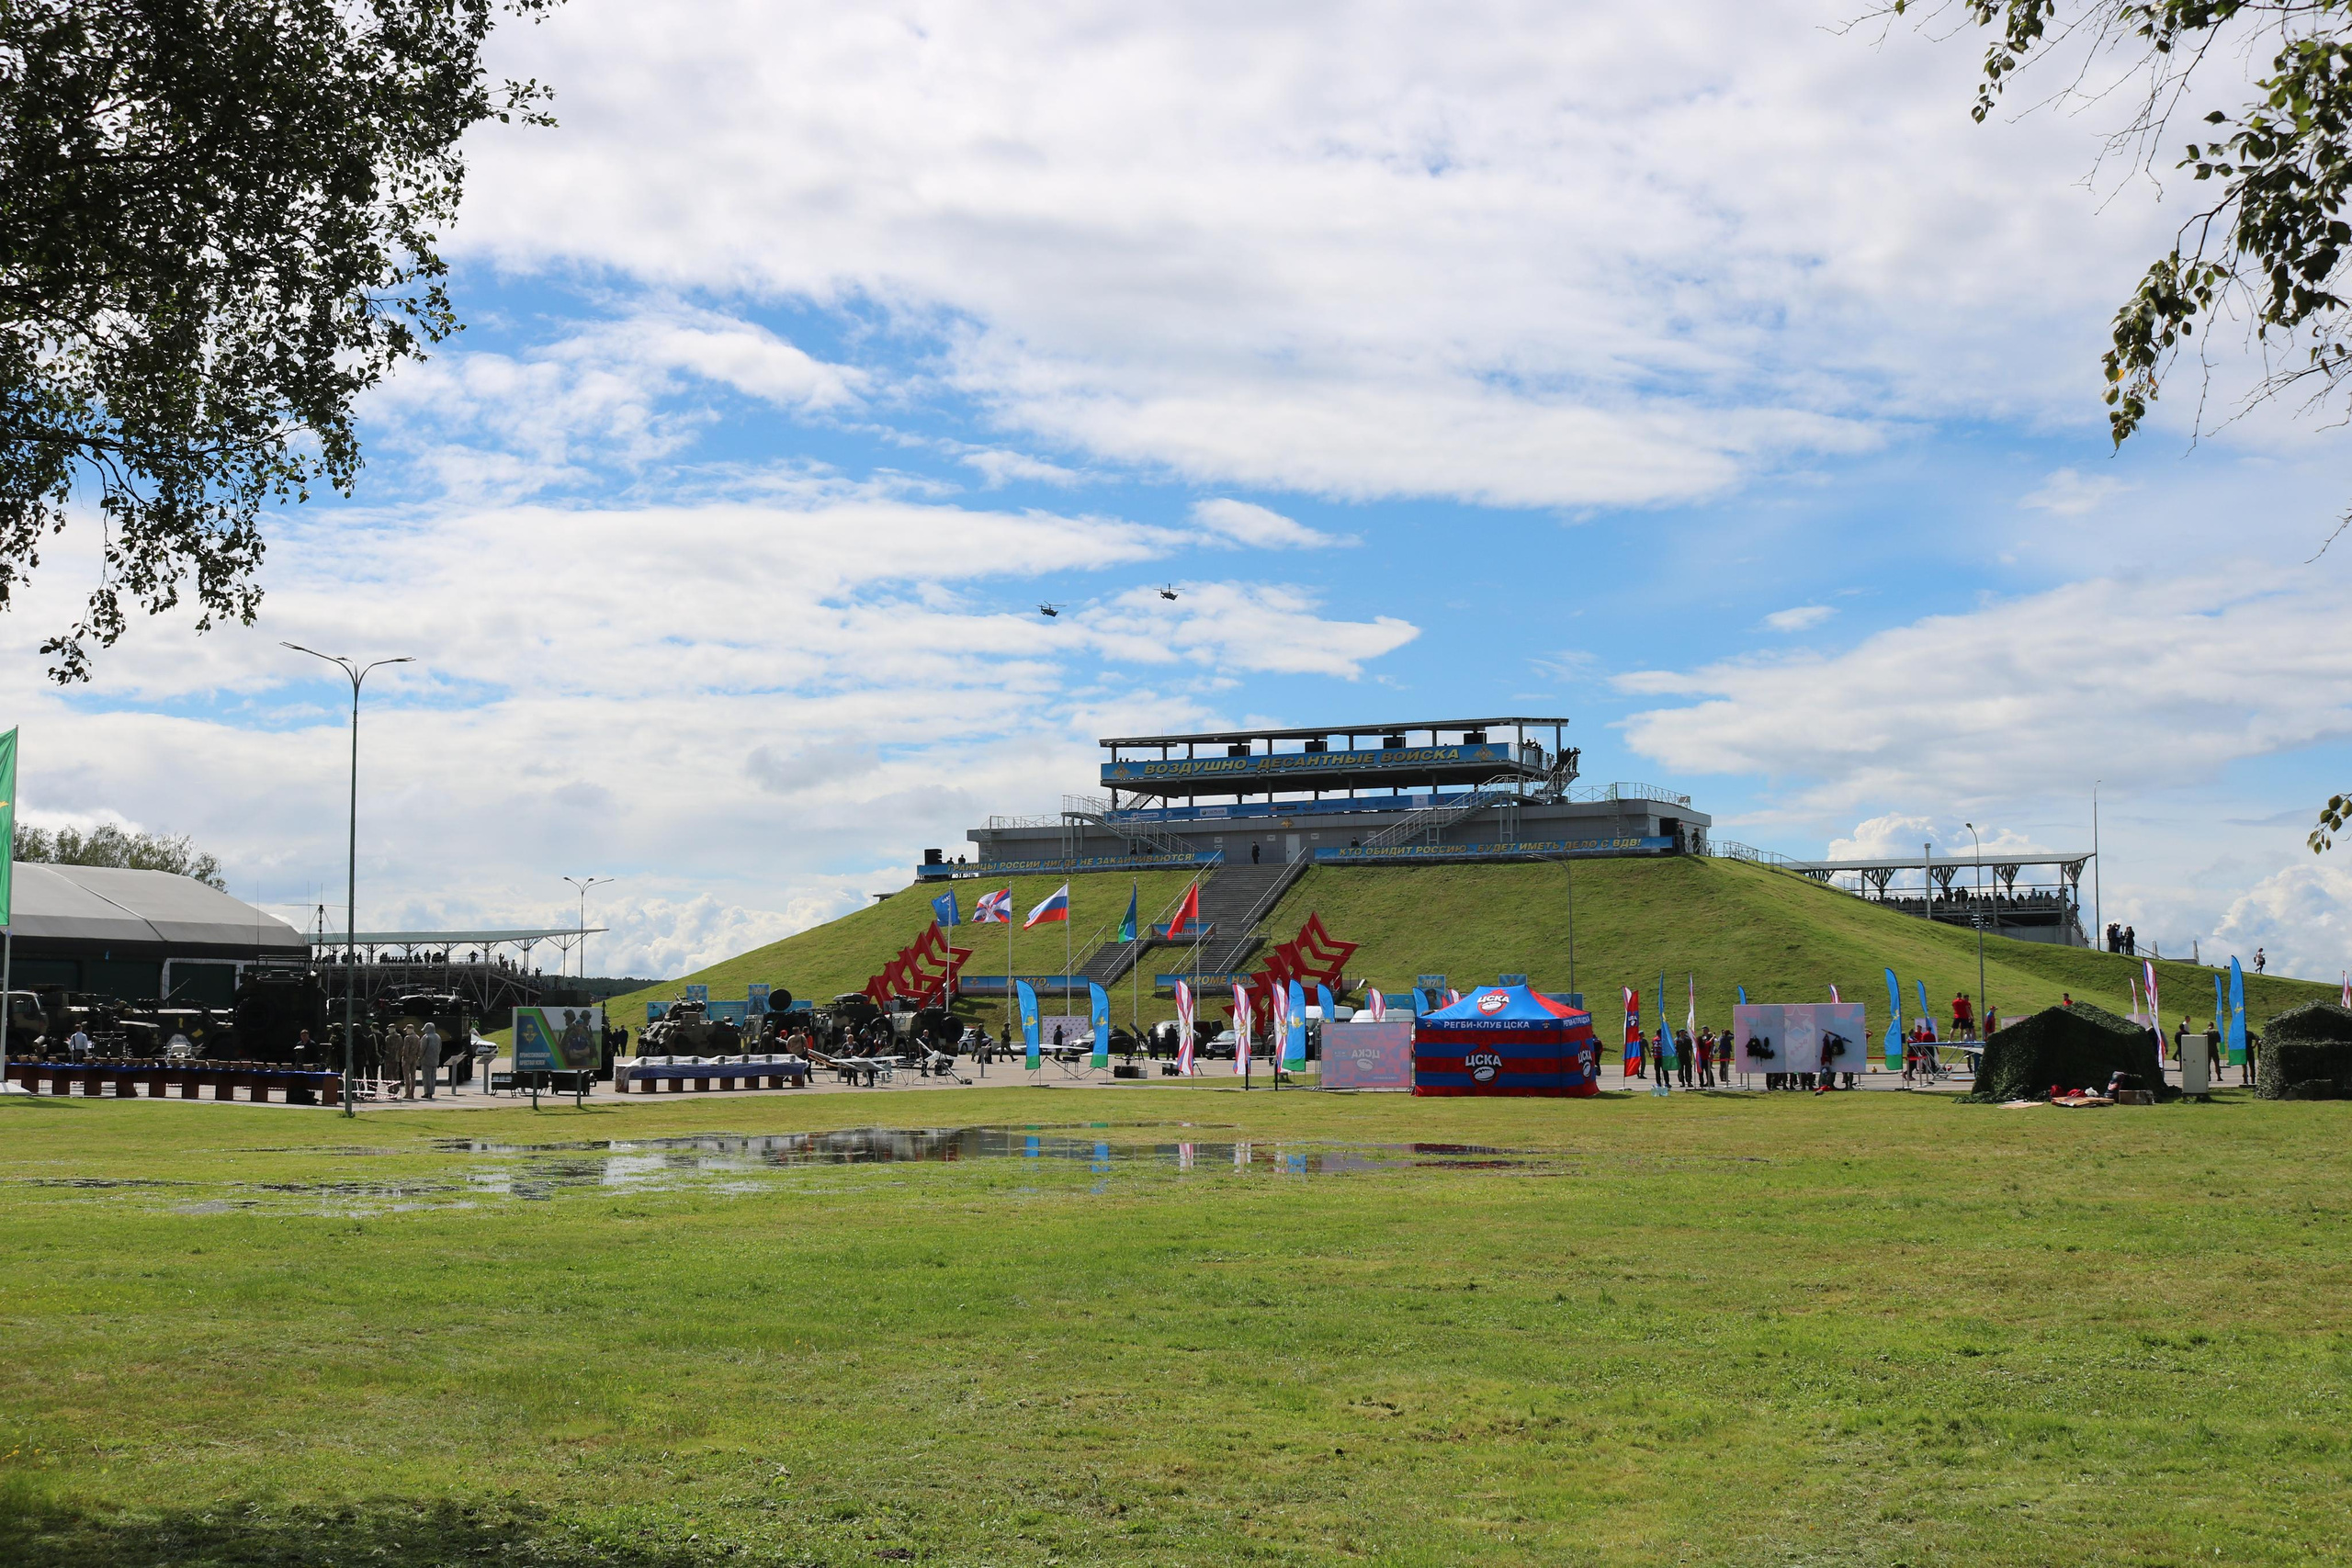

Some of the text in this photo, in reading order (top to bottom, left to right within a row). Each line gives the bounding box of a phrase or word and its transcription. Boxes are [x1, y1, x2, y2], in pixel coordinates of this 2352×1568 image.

[1144, 749, 1460, 774] ВОЗДУШНО-ДЕСАНТНЫЕ ВОЙСКА
[1339, 848, 1363, 856] КТО
[1365, 846, 1412, 855] ОБИДИТ
[1416, 844, 1467, 854] РОССИЮ
[1476, 843, 1516, 853] БУДЕТ
[1519, 841, 1559, 851] ИМЕТЬ
[1563, 840, 1597, 851] ДЕЛО
[1600, 840, 1609, 848] С
[1612, 838, 1642, 848] ВДВ!
[947, 863, 997, 872] ГРАНИЦЫ
[1000, 861, 1040, 869] РОССИИ
[1043, 859, 1077, 868] НИГДЕ
[1097, 853, 1194, 864] ЗАКАНЧИВАЮТСЯ!
[1006, 977, 1050, 987] НКТО,
[1185, 976, 1227, 985] КРОМЕ
[1421, 979, 1442, 988] 2020
[1476, 995, 1510, 1003] ЦСКА
[1443, 1021, 1530, 1030] РЕГБИ-КЛУБ ЦСКА
[1464, 1054, 1502, 1066] ЦСКА
[1577, 1050, 1592, 1064] ЦСКА
